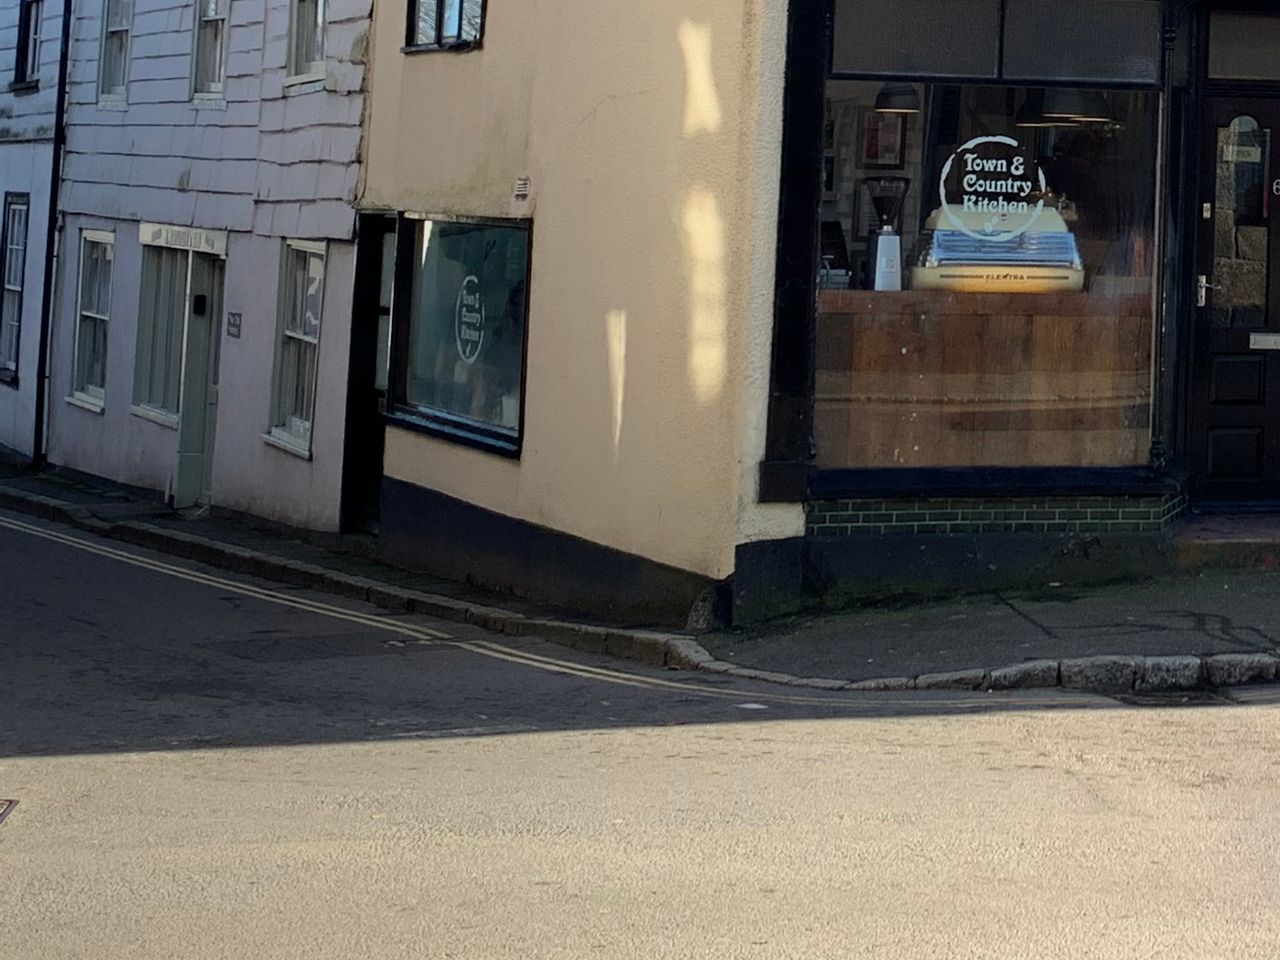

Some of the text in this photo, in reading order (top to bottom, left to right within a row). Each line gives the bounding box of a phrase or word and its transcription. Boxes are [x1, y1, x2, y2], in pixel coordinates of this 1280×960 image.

[963, 153, 1025, 175] Town &
[963, 173, 1032, 197] Country
[962, 194, 1028, 214] Kitchen
